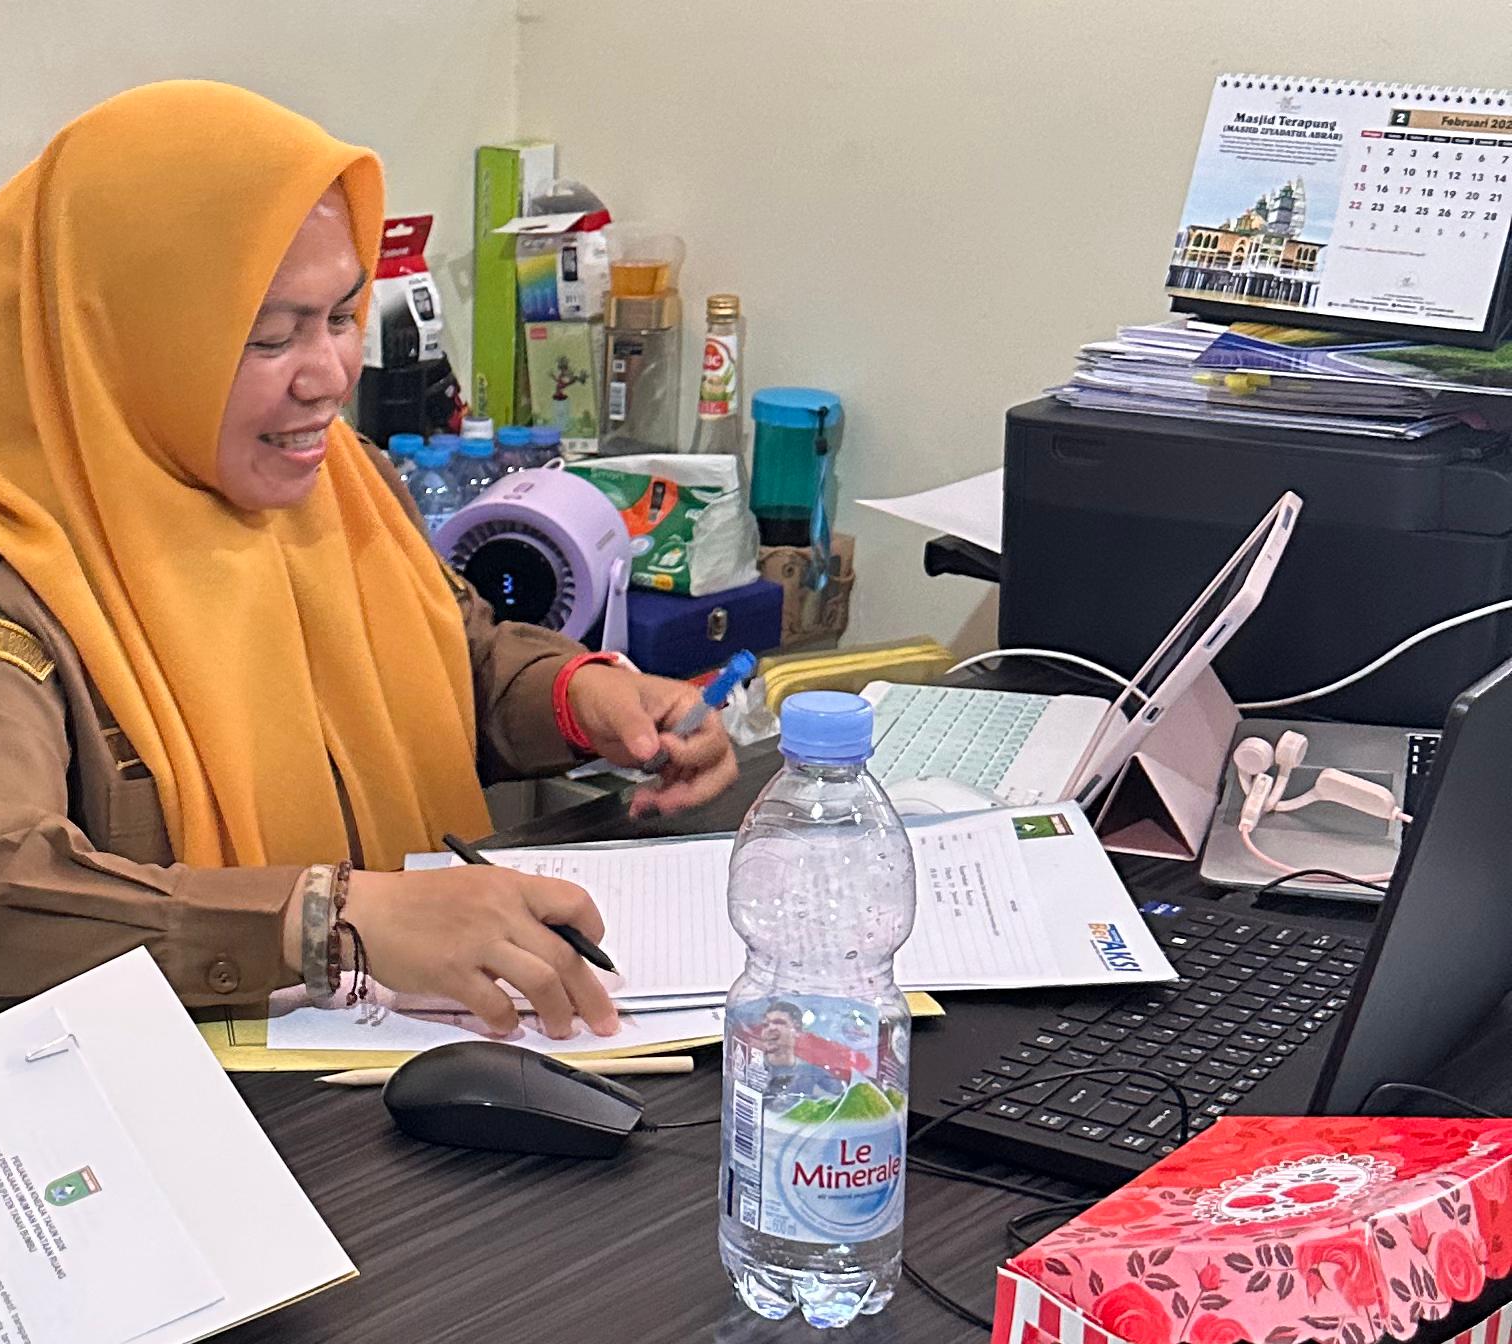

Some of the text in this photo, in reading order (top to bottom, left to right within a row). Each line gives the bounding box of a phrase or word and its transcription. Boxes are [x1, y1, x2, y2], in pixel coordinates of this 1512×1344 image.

[1234, 113, 1337, 131] Masjid Terapung
[1396, 113, 1405, 123] 2
[1441, 116, 1488, 127] Februari
[1388, 148, 1394, 156] 2
[1433, 151, 1439, 159] 4
[1502, 156, 1509, 164] 7
[1403, 168, 1416, 176] 10
[1426, 170, 1438, 178] 11
[1448, 172, 1461, 180] 12
[1472, 173, 1484, 182] 13
[1494, 175, 1506, 183] 14
[1354, 183, 1366, 191] 15
[1376, 185, 1388, 193] 16
[1421, 188, 1434, 196] 18
[1444, 191, 1456, 199] 19
[1465, 192, 1480, 200] 20
[1489, 194, 1502, 202] 21
[1349, 201, 1497, 221] 22 23 24 25 26 27 28
[840, 1140, 872, 1166] Le
[792, 1155, 901, 1189] Minerale
[10, 1155, 35, 1192] PERJANJIAN
[28, 1190, 48, 1216] KINERJA
[41, 1215, 59, 1238] TAHUN
[15, 1191, 31, 1211] UMUM
[24, 1209, 38, 1224] DAN
[9, 1210, 25, 1230] TANAH
[19, 1229, 37, 1253] BUMBU
[30, 1222, 55, 1257] PENATAAN
[47, 1255, 66, 1280] RUANG
